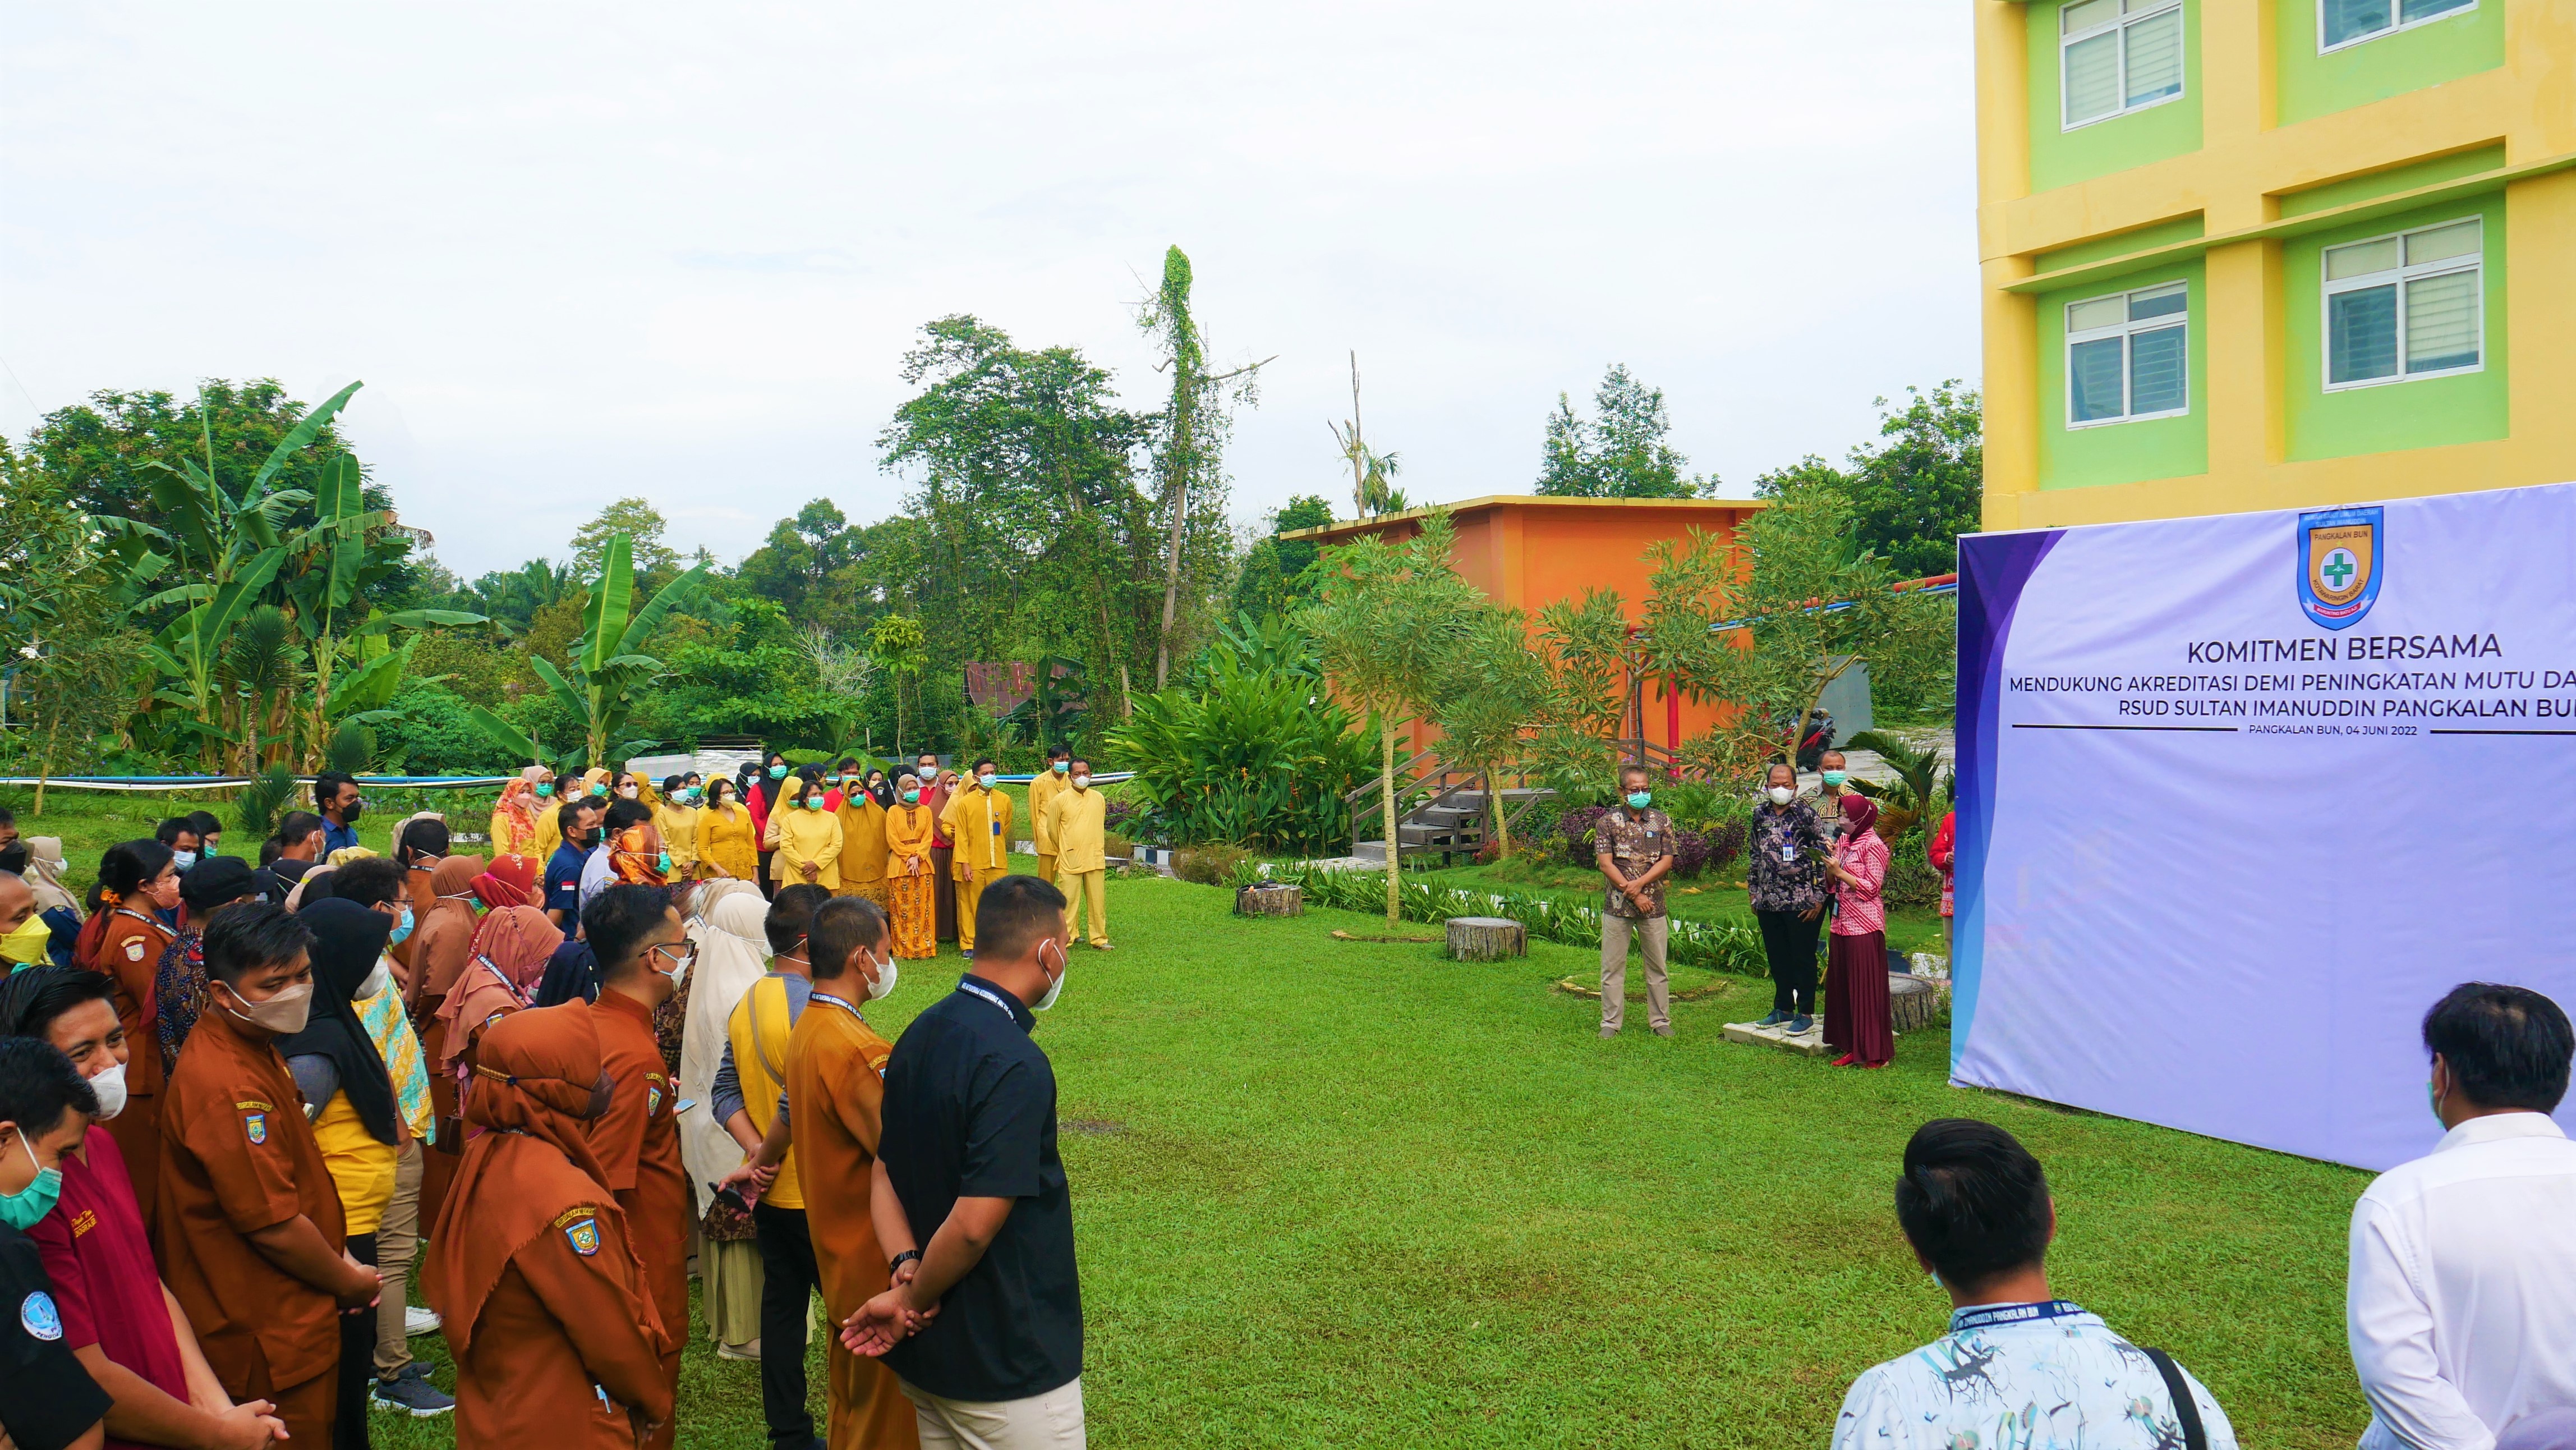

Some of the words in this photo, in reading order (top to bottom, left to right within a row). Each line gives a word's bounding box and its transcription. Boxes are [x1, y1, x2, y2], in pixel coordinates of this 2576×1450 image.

[2315, 531, 2352, 540] PANGKALAN
[2313, 579, 2349, 601] KOTAWARINGIN
[2349, 579, 2364, 596] BARAT
[2187, 637, 2338, 663] KOMITMEN
[2347, 633, 2503, 660] BERSAMA
[2010, 676, 2123, 692] MENDUKUNG
[2127, 675, 2238, 691] AKREDITASI
[2244, 674, 2295, 691] DEMI
[2302, 672, 2457, 691] PENINGKATAN
[2464, 671, 2535, 690] MUTU
[2119, 700, 2169, 716] RSUD
[2174, 700, 2247, 716] SULTAN
[2253, 700, 2376, 717] IMANUDDIN
[2382, 699, 2527, 717] PANGKALAN
[2536, 699, 2576, 718] BU
[2249, 724, 2313, 735] PANGKALAN
[2317, 725, 2343, 736] BUN,
[2345, 726, 2360, 735] 04
[2362, 726, 2388, 735] JUNI
[2391, 726, 2418, 736] 2022
[1993, 1307, 2027, 1321] PANGKALAN
[2026, 1306, 2040, 1318] BUN
